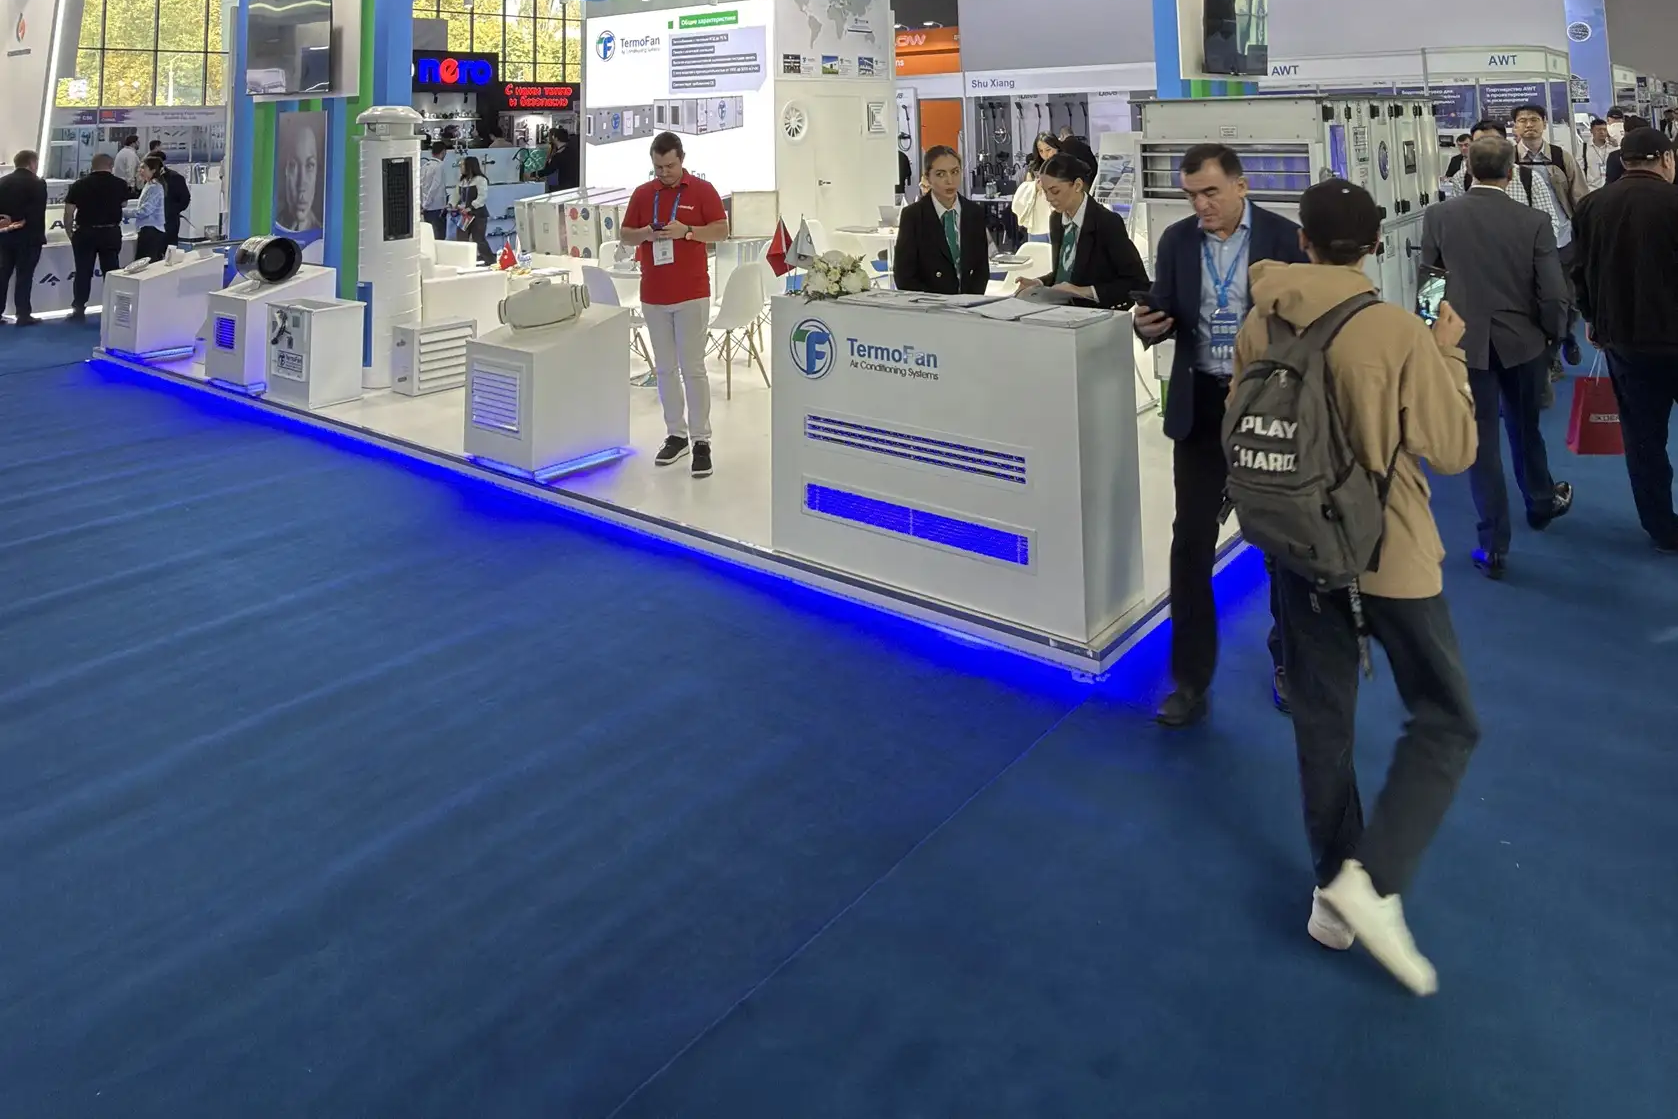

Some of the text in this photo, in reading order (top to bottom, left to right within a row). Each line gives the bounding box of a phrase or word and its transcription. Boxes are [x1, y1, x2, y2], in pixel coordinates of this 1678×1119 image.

[619, 35, 661, 48] TermoFan
[1488, 54, 1517, 66] AWT
[418, 57, 493, 86] nero
[1271, 65, 1299, 76] AWT
[971, 78, 1015, 89] Shu Xiang
[846, 337, 938, 369] TermoFan
[850, 359, 939, 381] Air Conditioning Systems
[1240, 415, 1299, 439] PLAY
